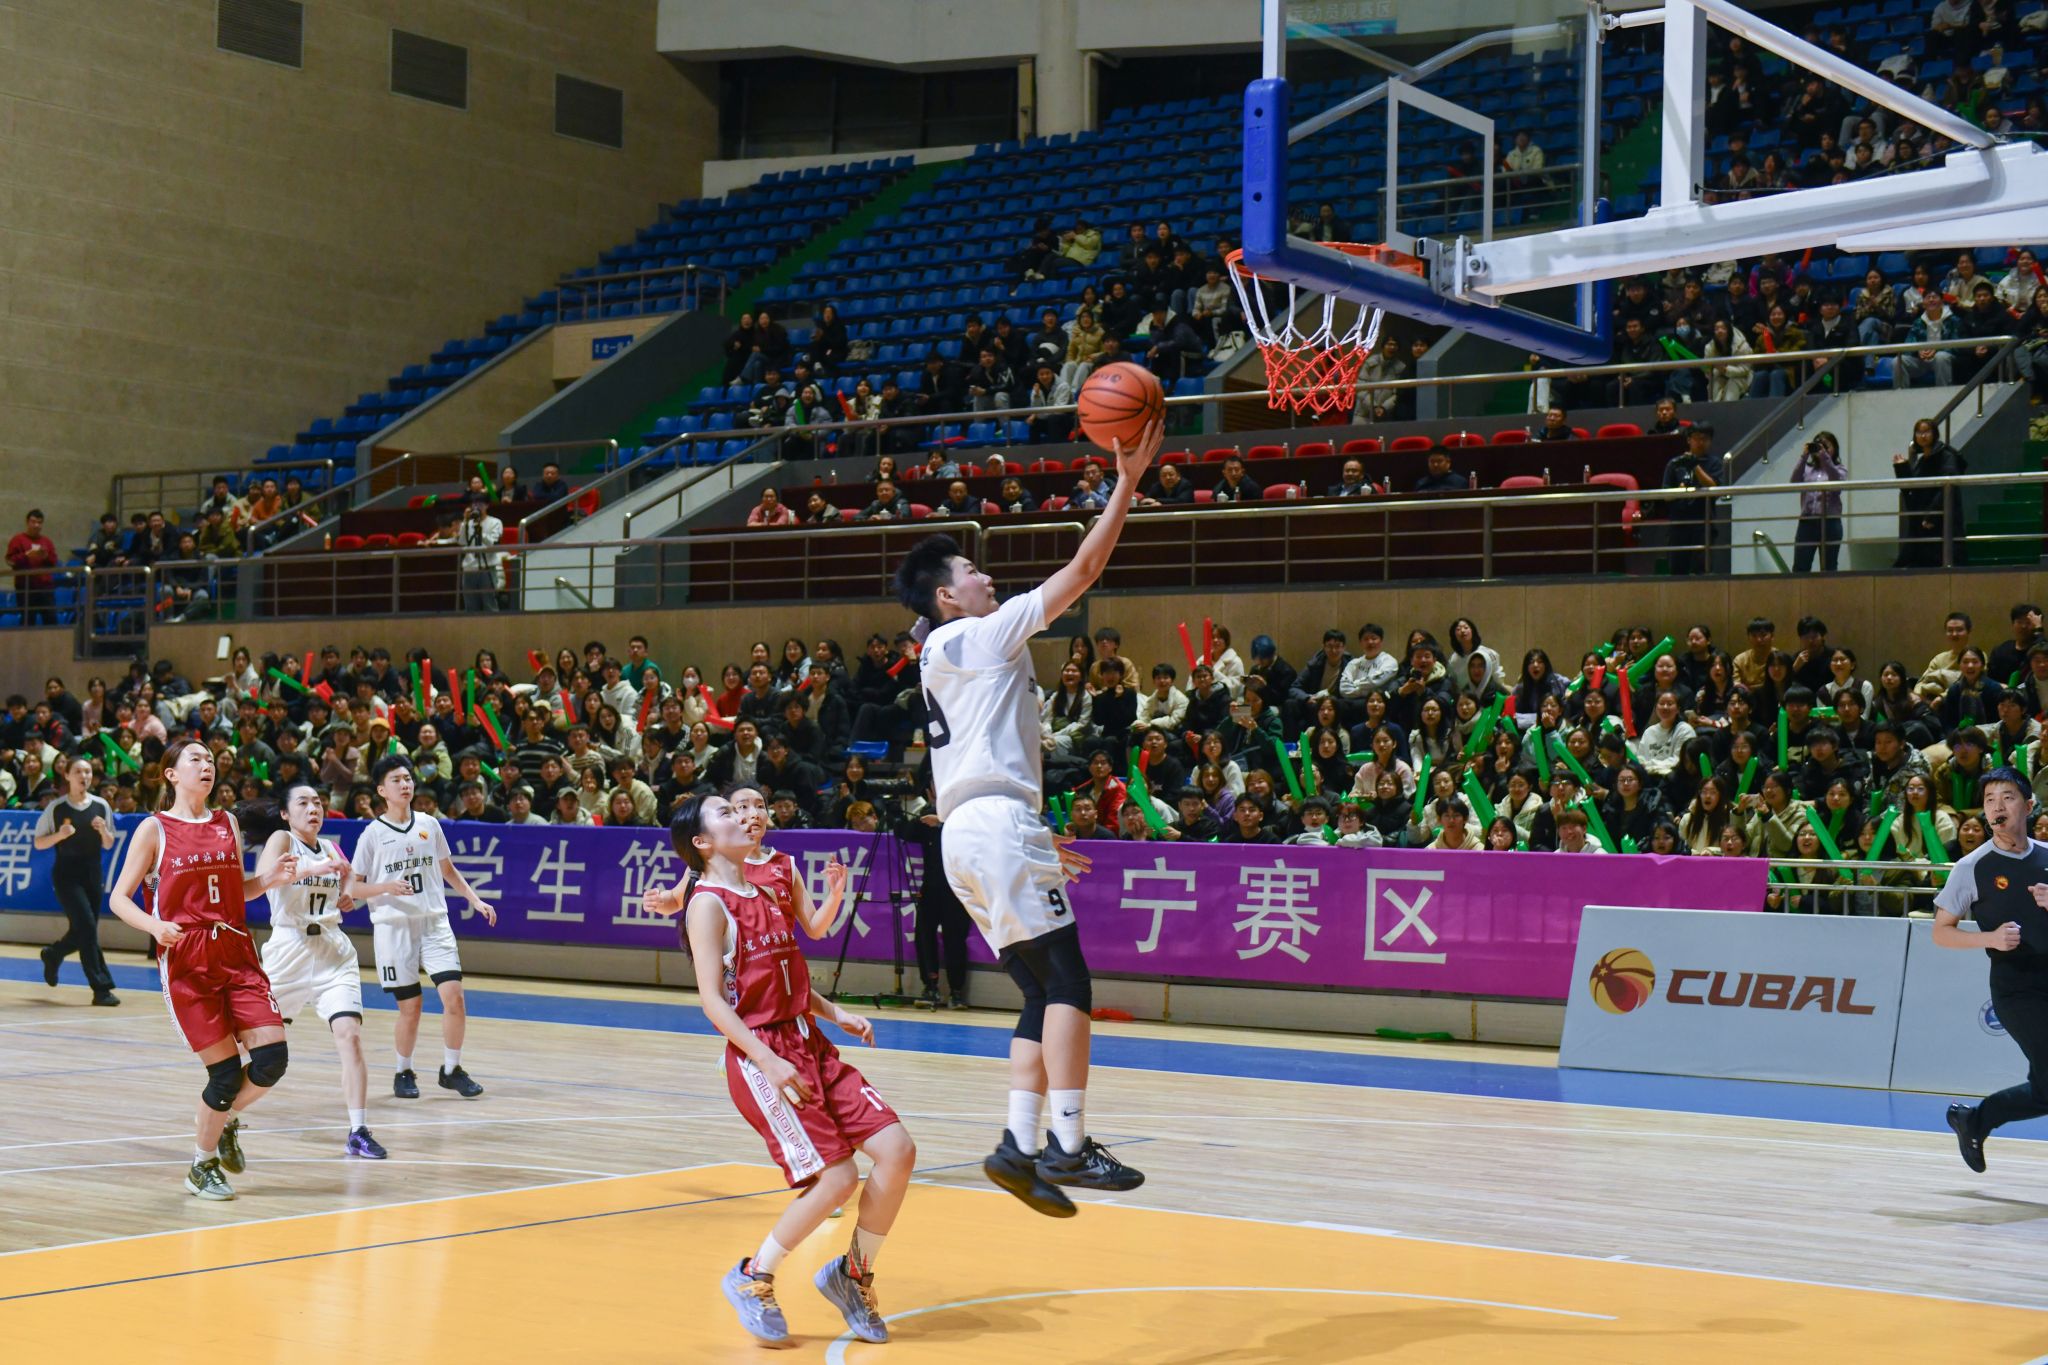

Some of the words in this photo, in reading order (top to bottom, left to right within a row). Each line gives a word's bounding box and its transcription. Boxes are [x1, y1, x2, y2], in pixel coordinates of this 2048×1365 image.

[207, 874, 220, 904] 6
[1048, 888, 1067, 917] 9
[309, 893, 327, 915] 17
[382, 965, 397, 981] 10
[780, 959, 792, 996] 17
[1666, 969, 1876, 1016] CUBAL
